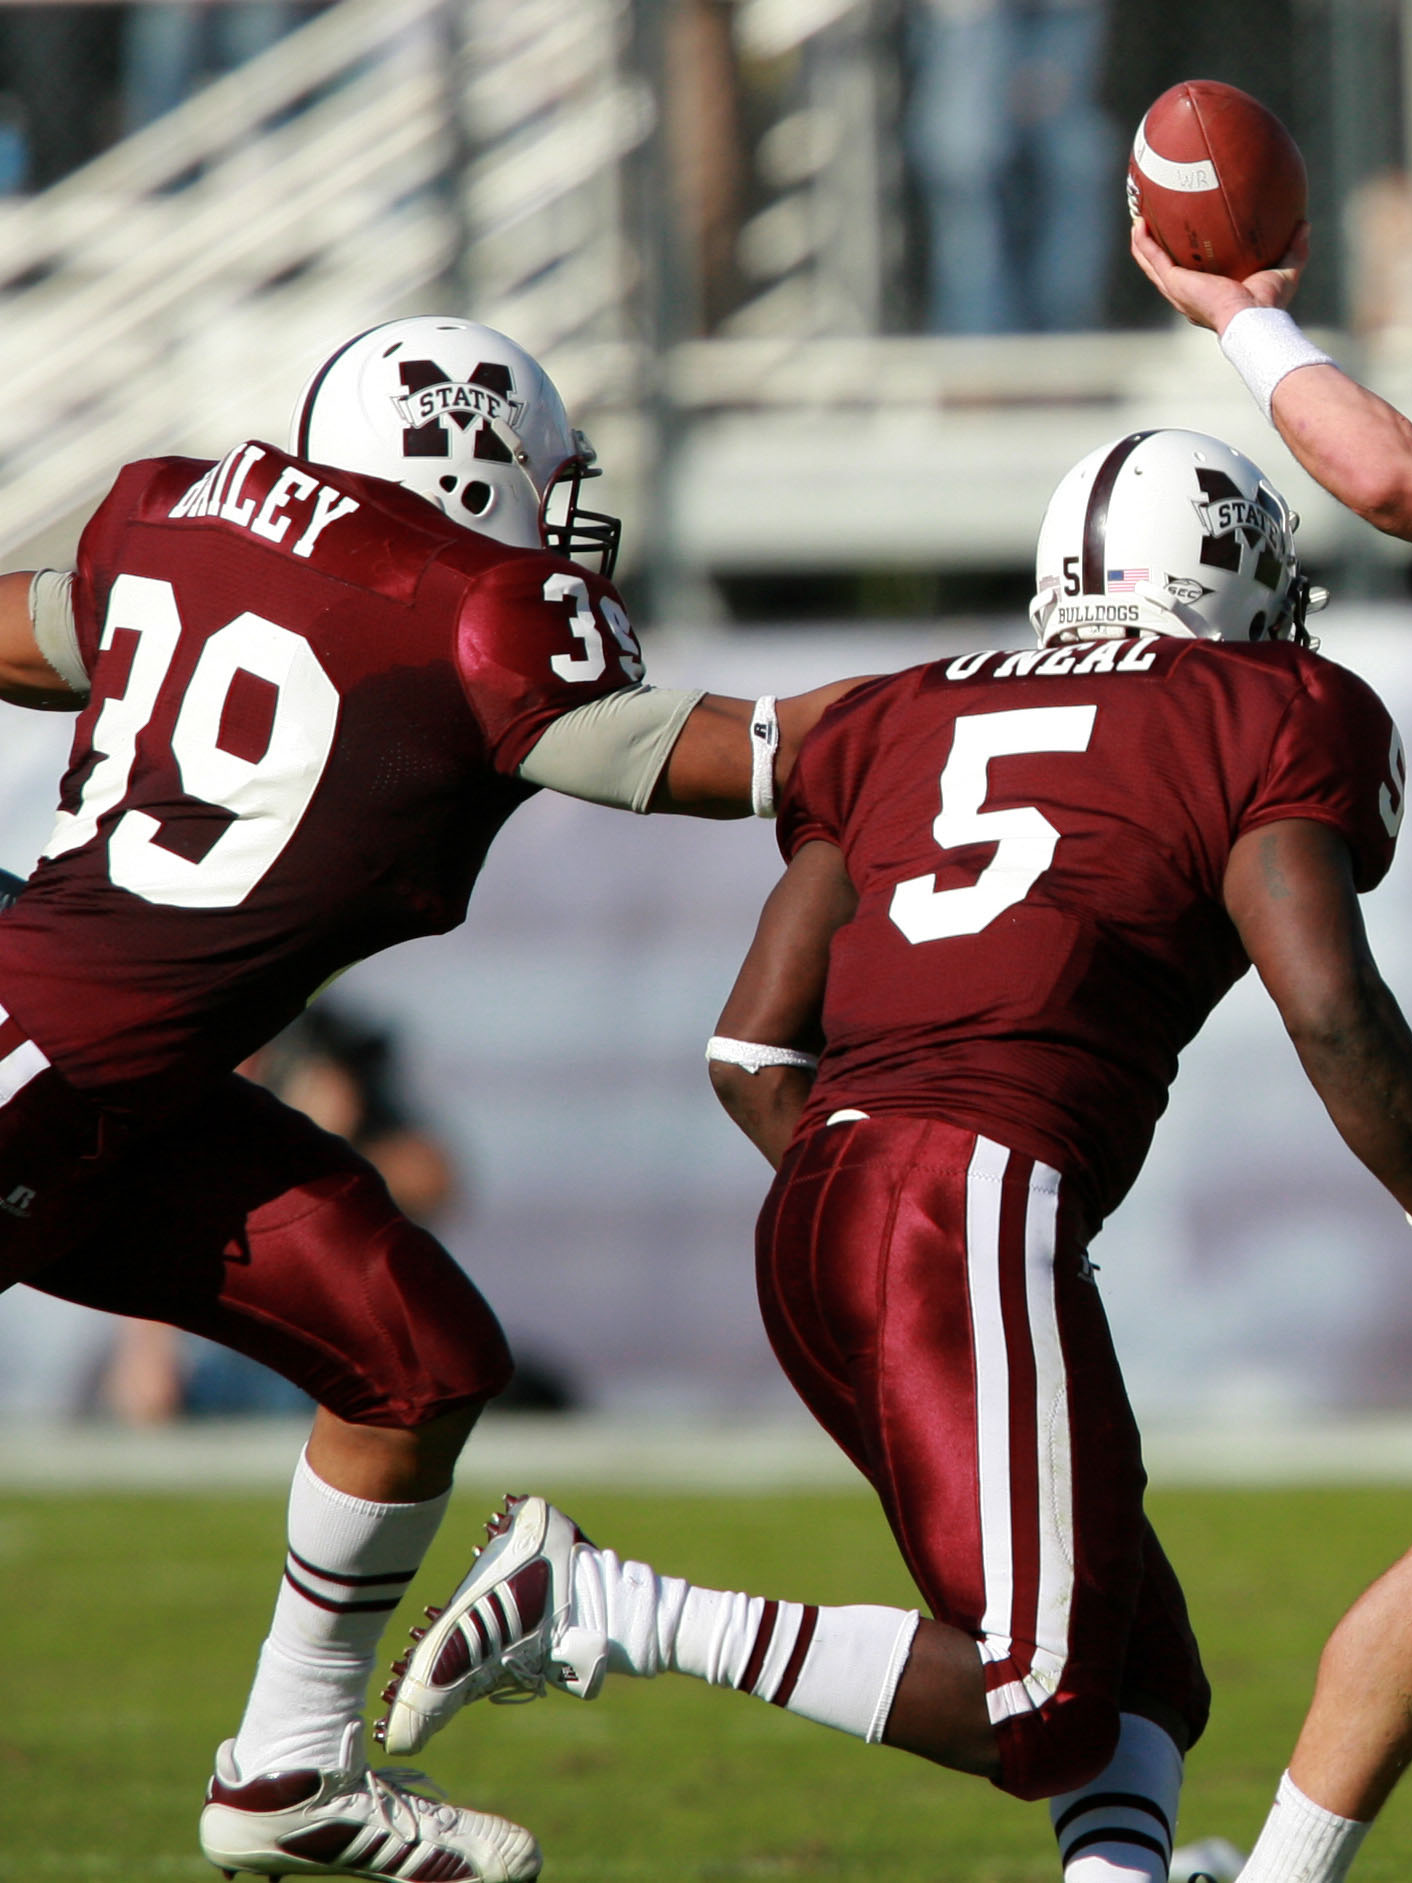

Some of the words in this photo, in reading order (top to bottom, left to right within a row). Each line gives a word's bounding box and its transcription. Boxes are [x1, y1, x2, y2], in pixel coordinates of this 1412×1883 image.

[419, 387, 500, 418] STATE
[1063, 556, 1080, 596] 5
[1167, 586, 1200, 599] SEC
[543, 573, 640, 682] 39
[1058, 605, 1139, 624] BULLDOGS
[40, 573, 340, 908] 39
[888, 704, 1098, 945] 5
